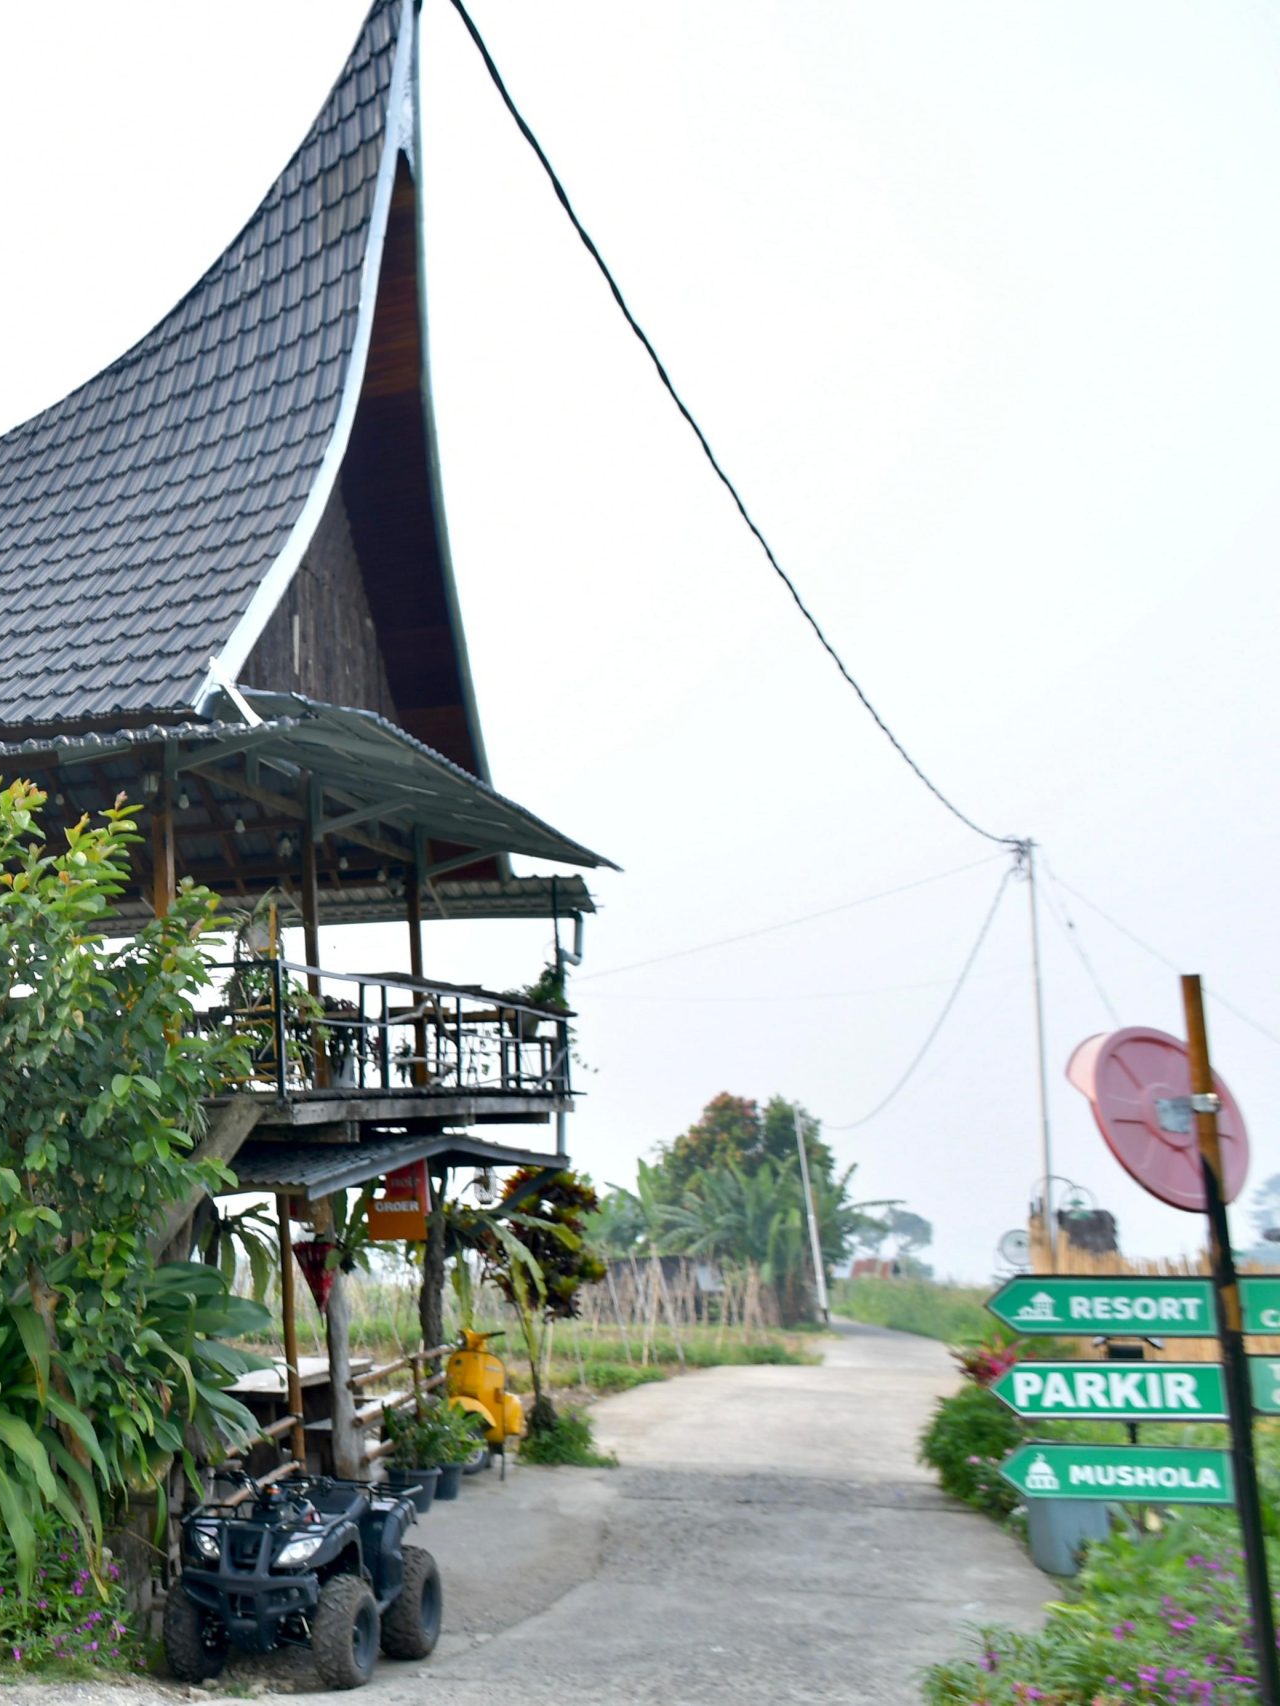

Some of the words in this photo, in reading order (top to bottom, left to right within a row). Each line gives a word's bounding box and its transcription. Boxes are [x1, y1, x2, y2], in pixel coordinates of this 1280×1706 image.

[1069, 1295, 1203, 1321] RESORT
[1012, 1371, 1202, 1410] PARKIR
[1069, 1464, 1220, 1489] MUSHOLA
